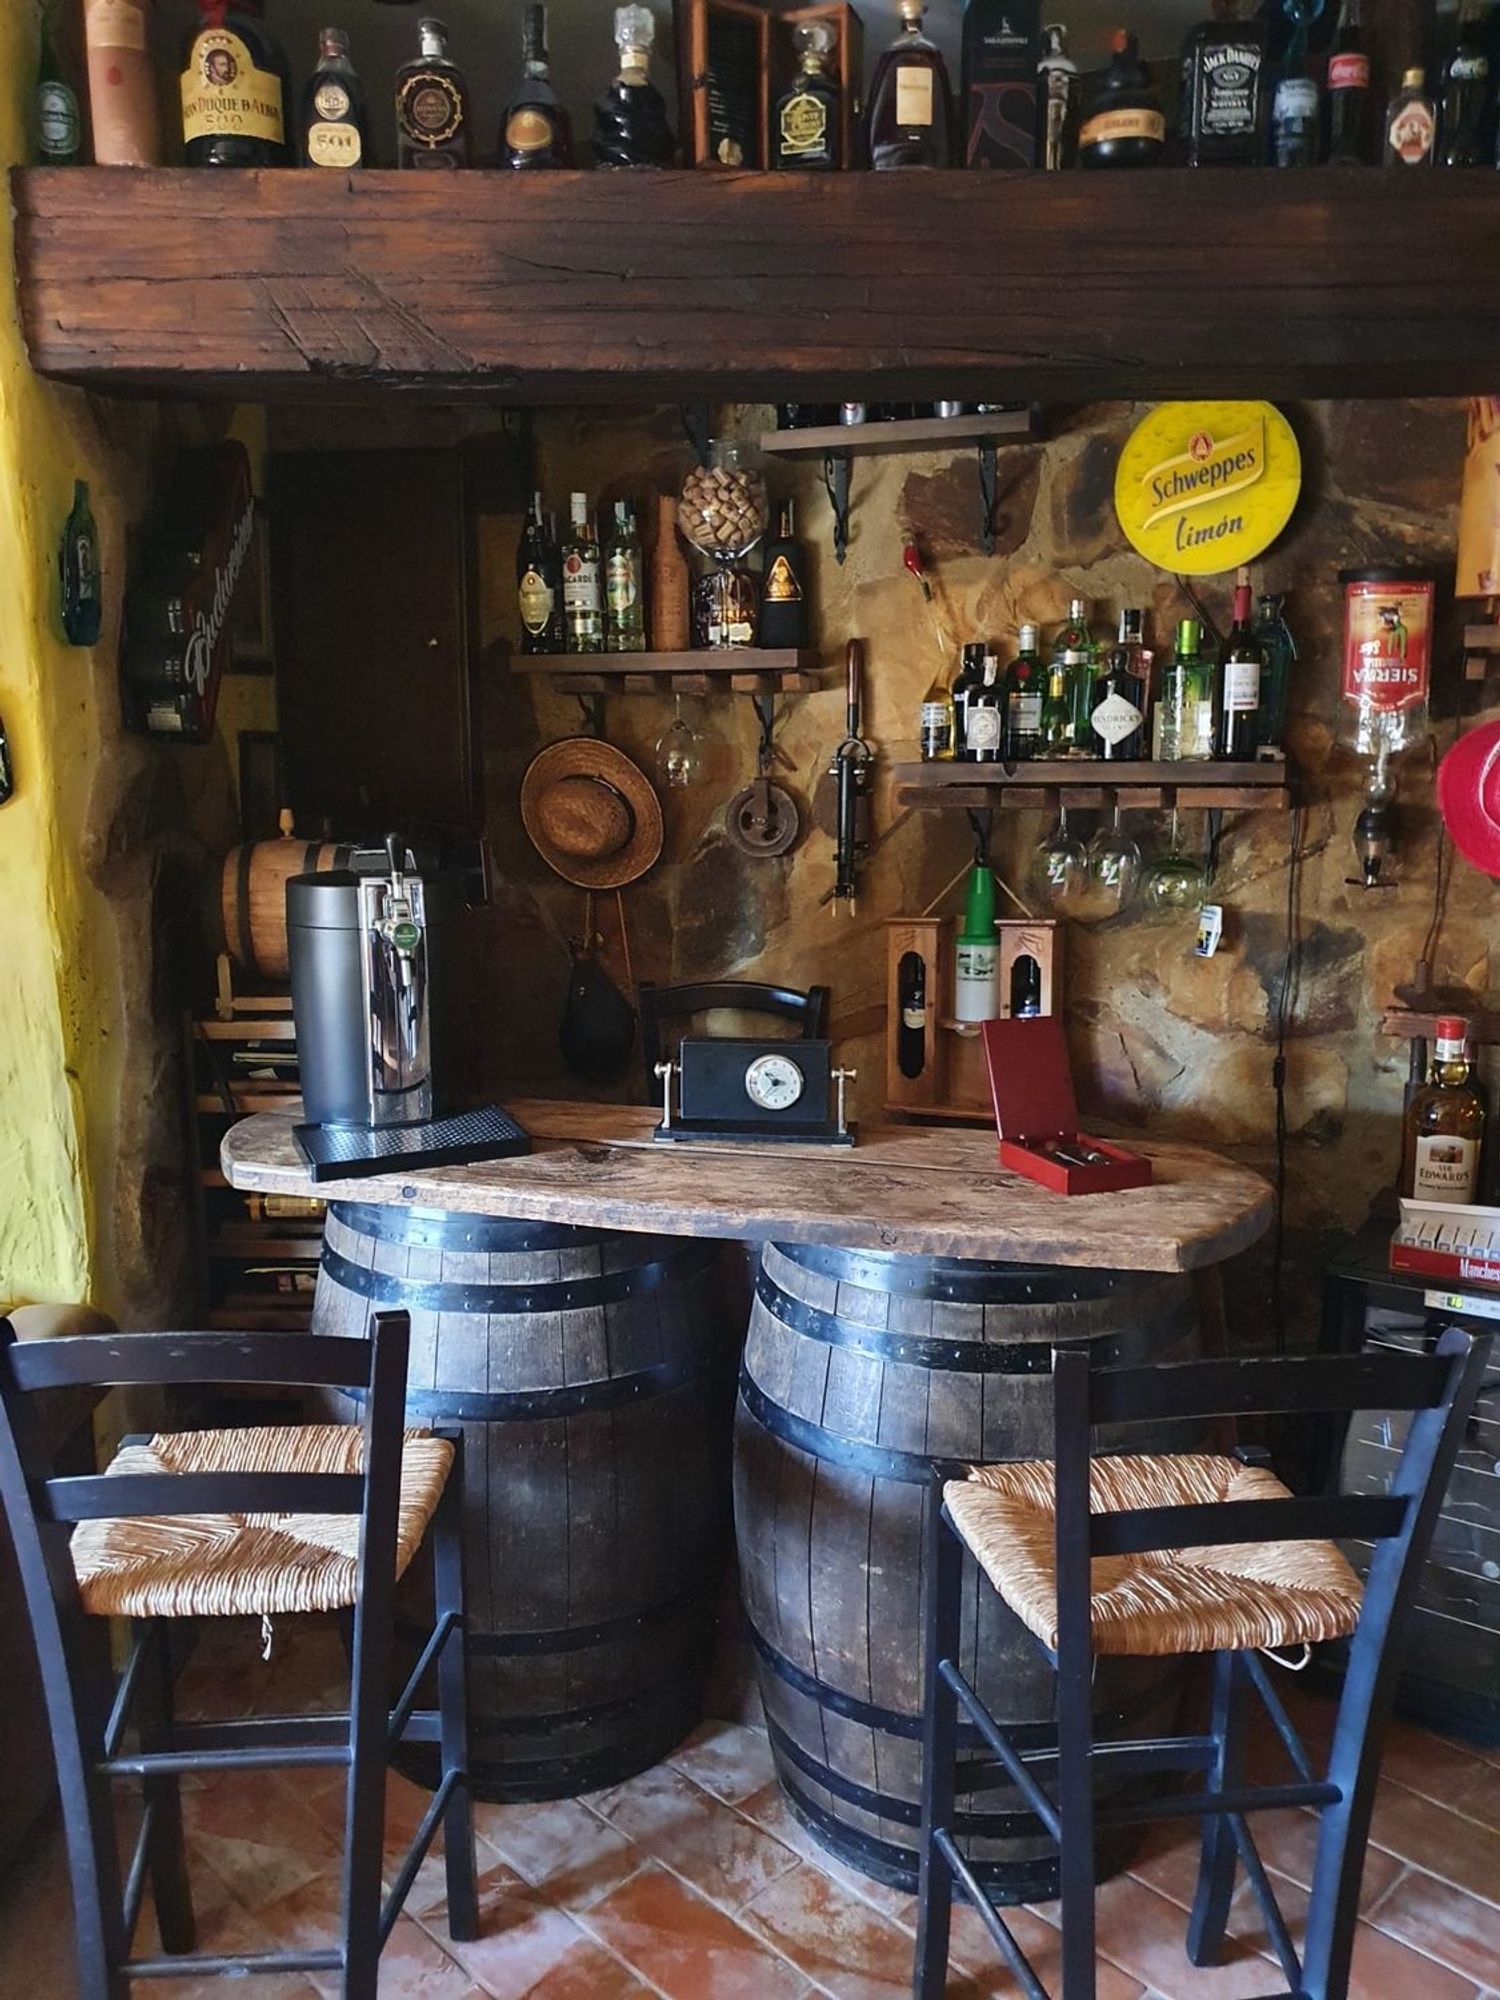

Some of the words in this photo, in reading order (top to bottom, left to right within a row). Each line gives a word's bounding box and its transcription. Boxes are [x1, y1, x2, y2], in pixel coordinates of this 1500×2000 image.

[1202, 53, 1227, 74] JACK
[1152, 447, 1256, 507] Schweppes
[1353, 667, 1419, 684] SIERRA
